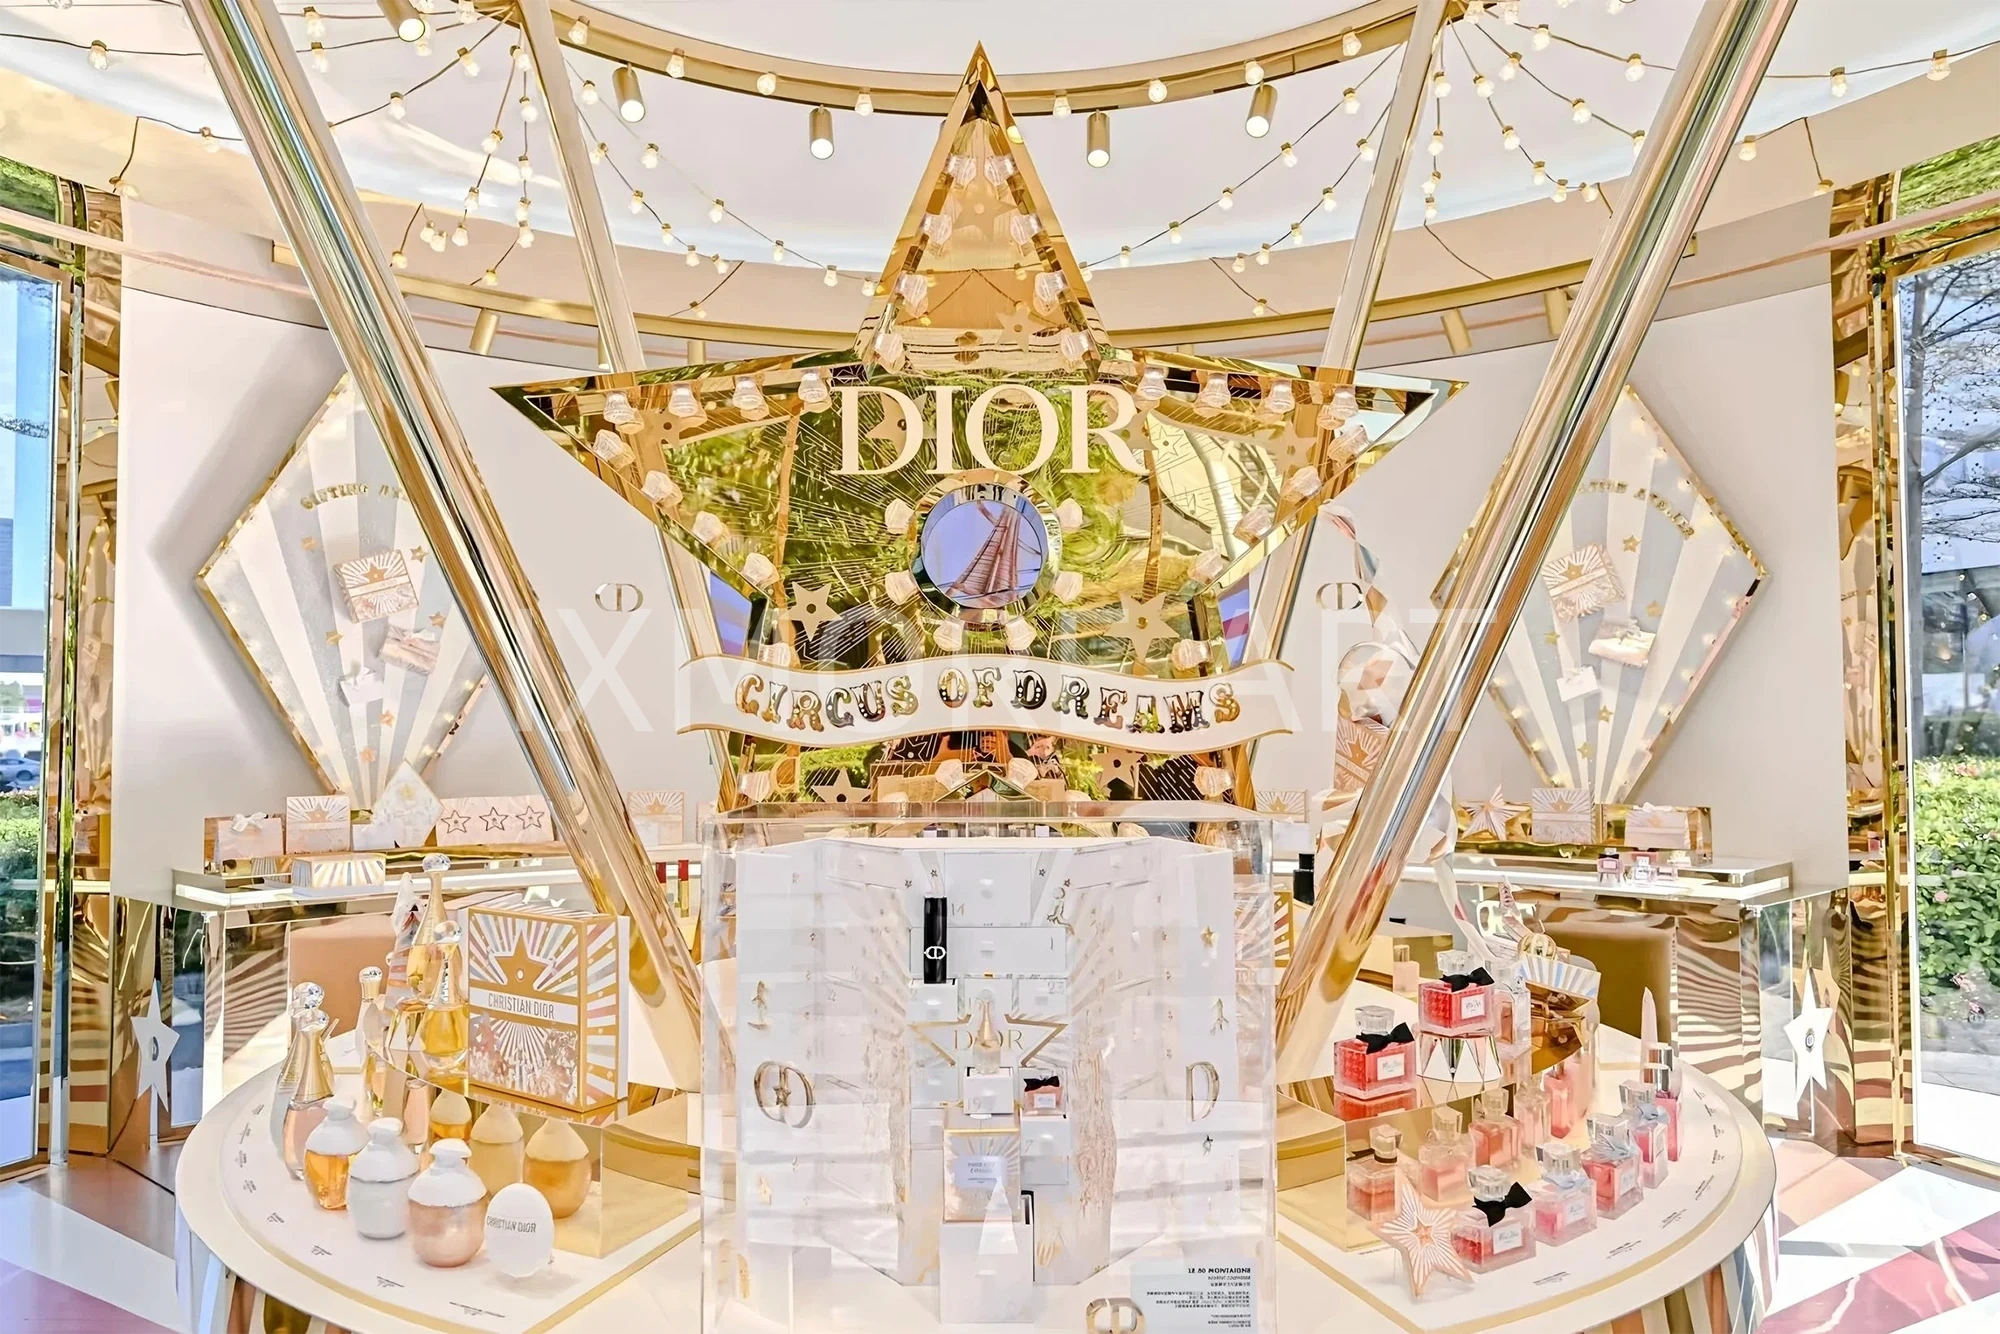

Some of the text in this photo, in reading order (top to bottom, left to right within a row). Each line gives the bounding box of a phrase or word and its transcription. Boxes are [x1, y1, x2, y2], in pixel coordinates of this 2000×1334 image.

[829, 384, 1148, 475] DIOR
[733, 665, 1243, 735] CIRCUS OF DREAMS
[488, 992, 555, 1020] CHRISTIAN DIOR
[953, 1029, 1024, 1051] DR
[517, 1222, 537, 1234] DIOR
